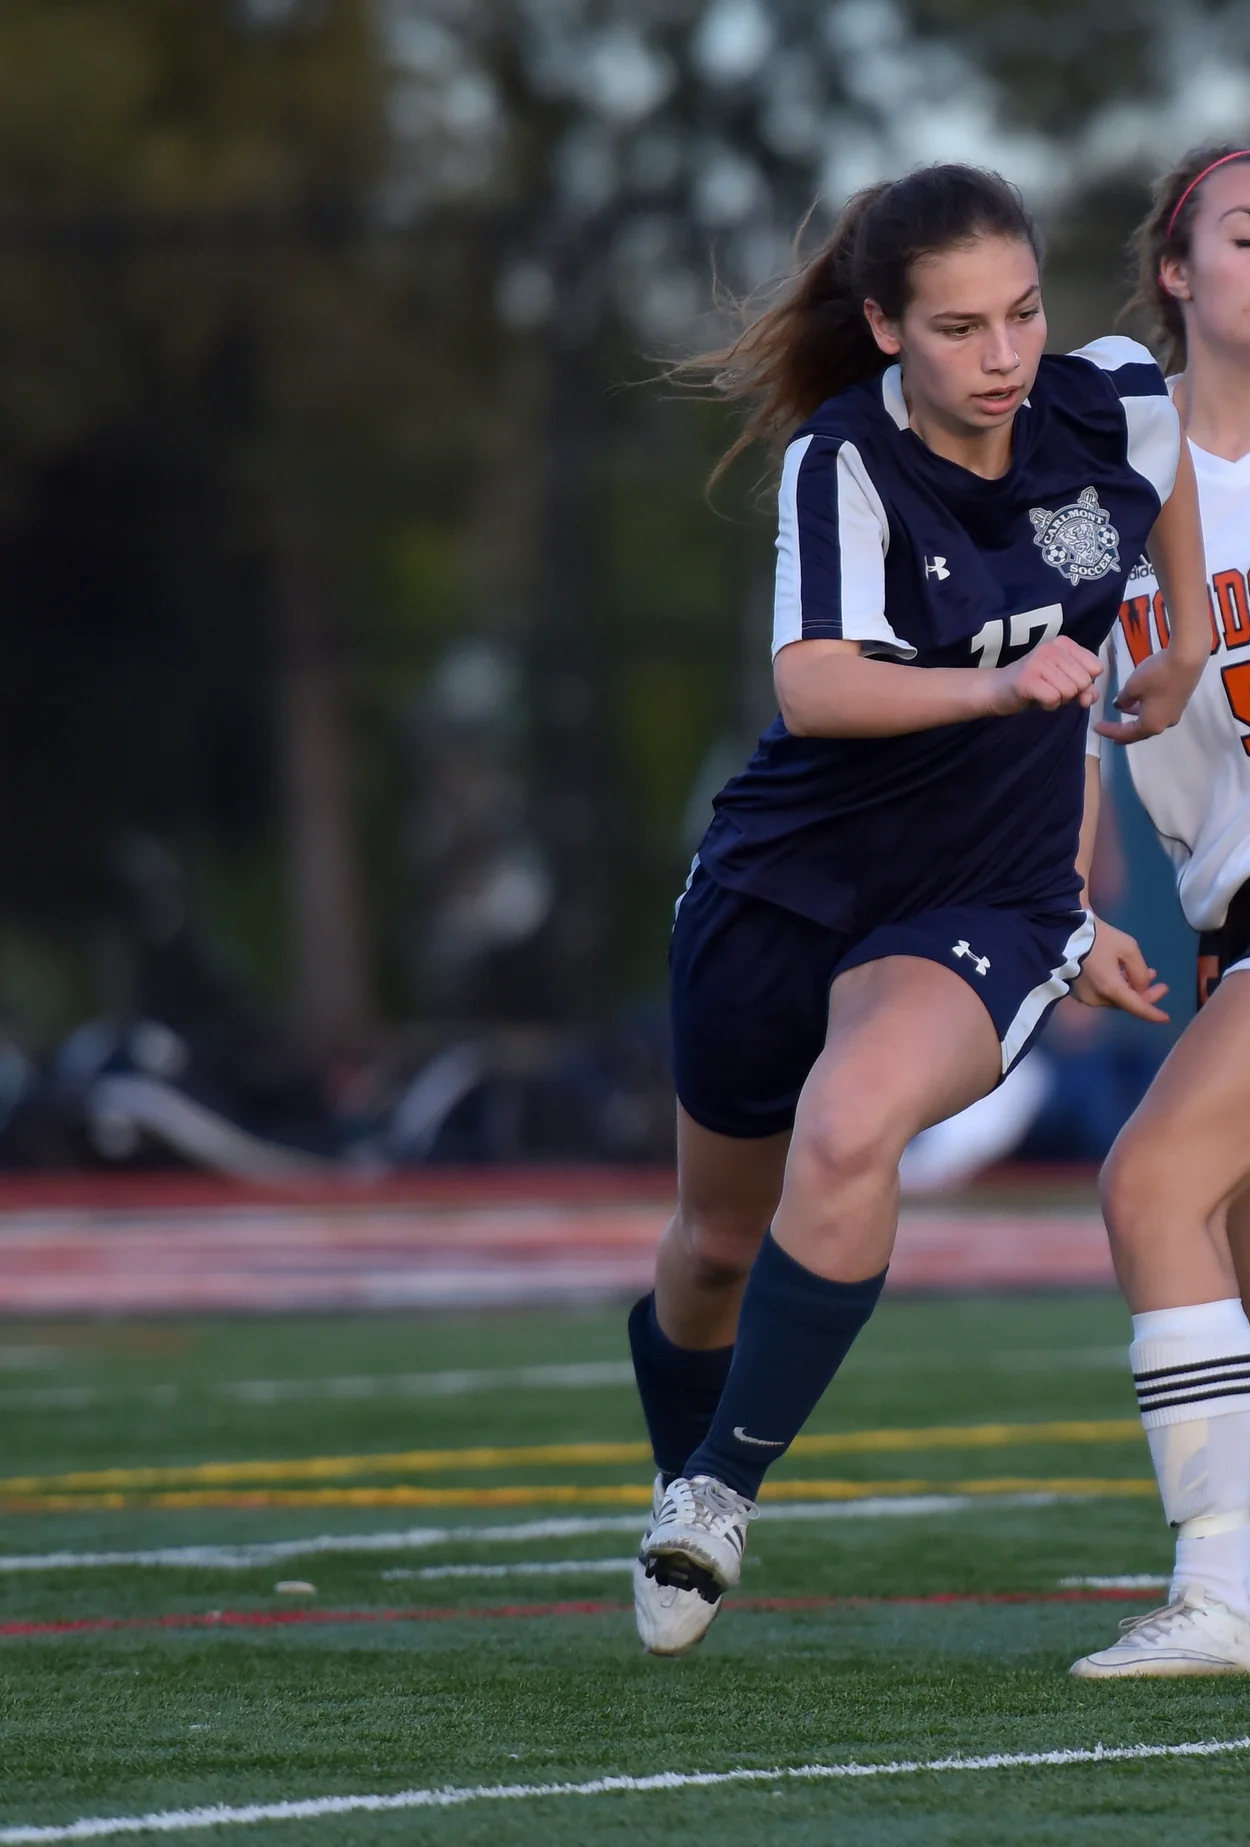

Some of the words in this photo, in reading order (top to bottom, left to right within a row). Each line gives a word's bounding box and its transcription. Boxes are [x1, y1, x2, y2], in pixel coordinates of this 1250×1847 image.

[1044, 509, 1105, 544] CARLMONT
[1070, 553, 1113, 576] SOCCER
[970, 603, 1064, 668] 17
